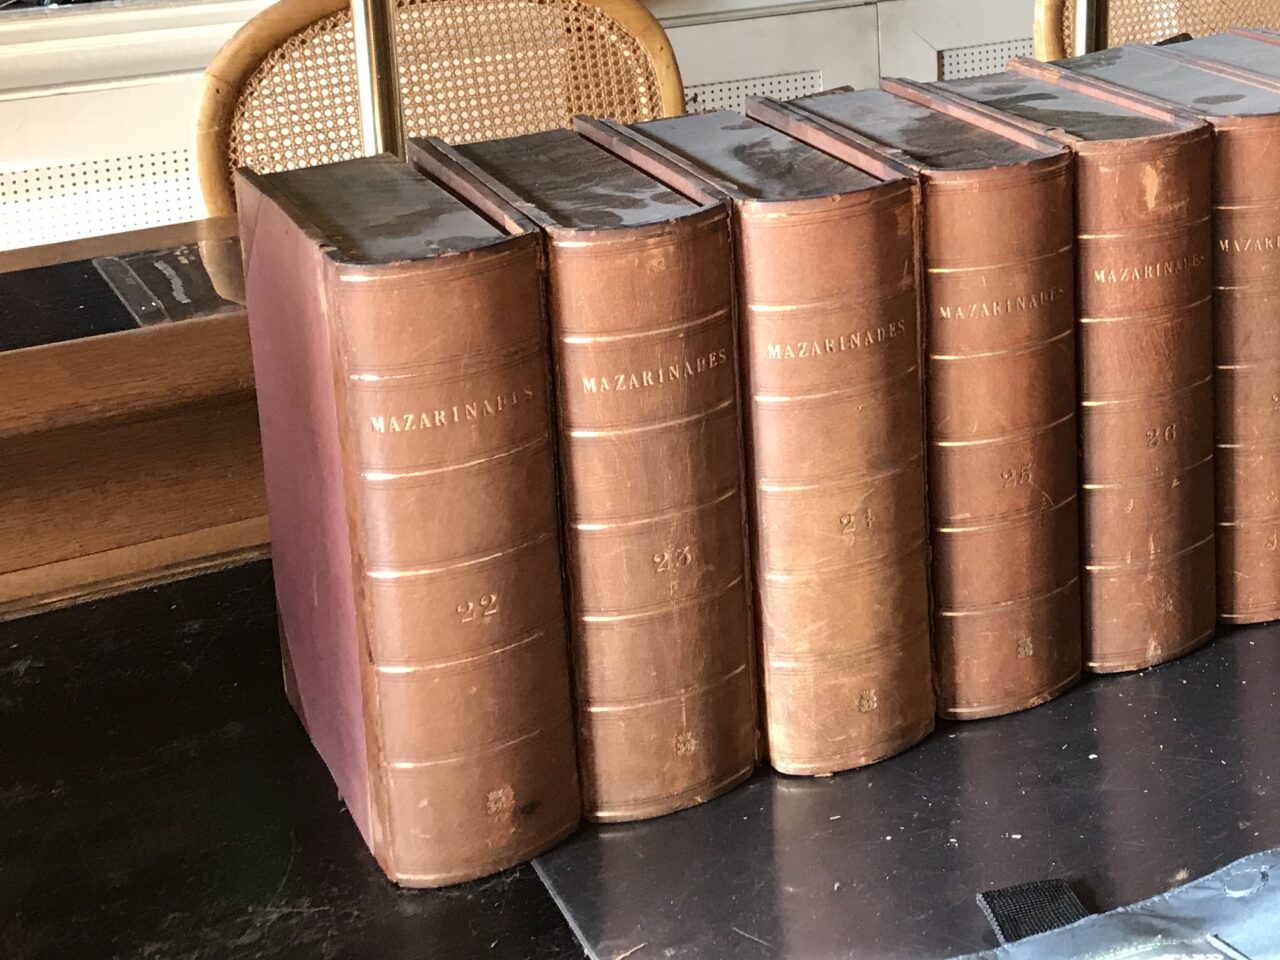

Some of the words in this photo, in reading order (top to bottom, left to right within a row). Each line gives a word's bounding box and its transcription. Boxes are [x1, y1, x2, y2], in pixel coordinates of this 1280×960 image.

[767, 318, 906, 361] MAZARINADES
[582, 348, 727, 394] MAZARINADES
[653, 545, 693, 574] 23
[456, 592, 498, 624] 22
